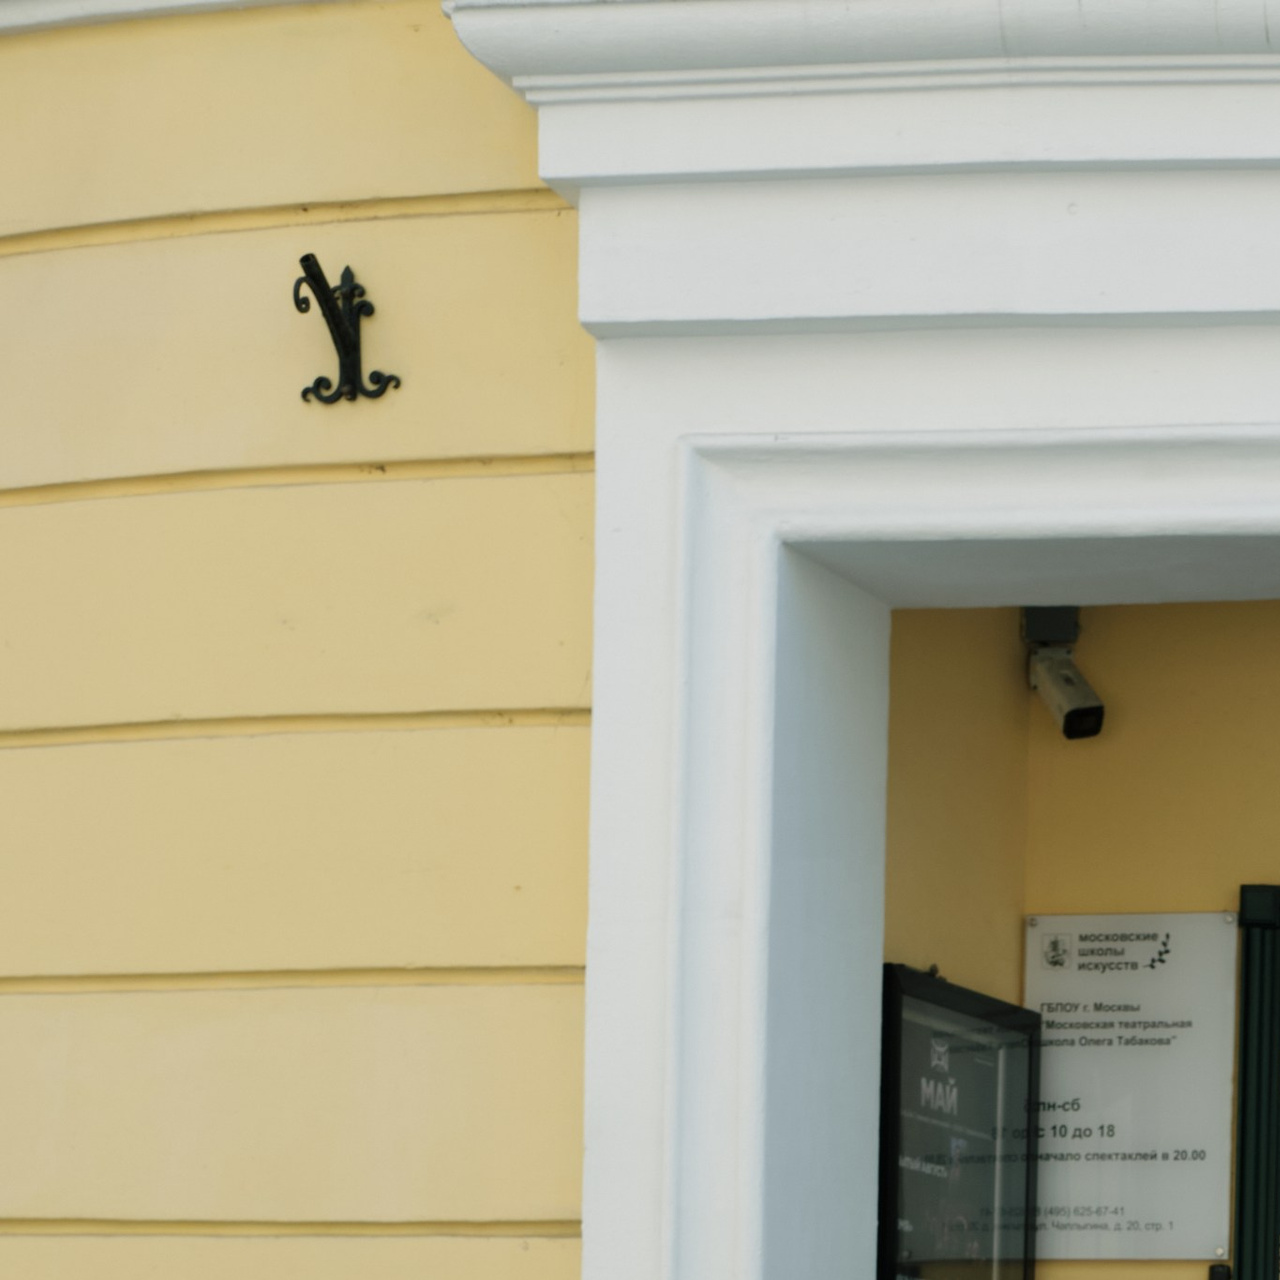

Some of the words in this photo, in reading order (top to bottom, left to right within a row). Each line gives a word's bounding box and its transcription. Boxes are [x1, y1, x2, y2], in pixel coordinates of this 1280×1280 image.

[1078, 933, 1158, 942] московские
[1077, 948, 1125, 956] школы
[1077, 962, 1138, 974] искусств
[1040, 1002, 1080, 1013] ГБПОУ
[1093, 1002, 1141, 1012] Москвы
[1118, 1020, 1193, 1031] театральная
[1079, 1036, 1113, 1047] Олега
[920, 1077, 958, 1117] МАЙ
[1051, 1124, 1068, 1138] 10
[1071, 1127, 1093, 1139] до
[1098, 1124, 1116, 1138] 18
[1085, 1149, 1157, 1162] спектаклей
[1161, 1152, 1169, 1161] в
[1173, 1149, 1207, 1161] 20.00
